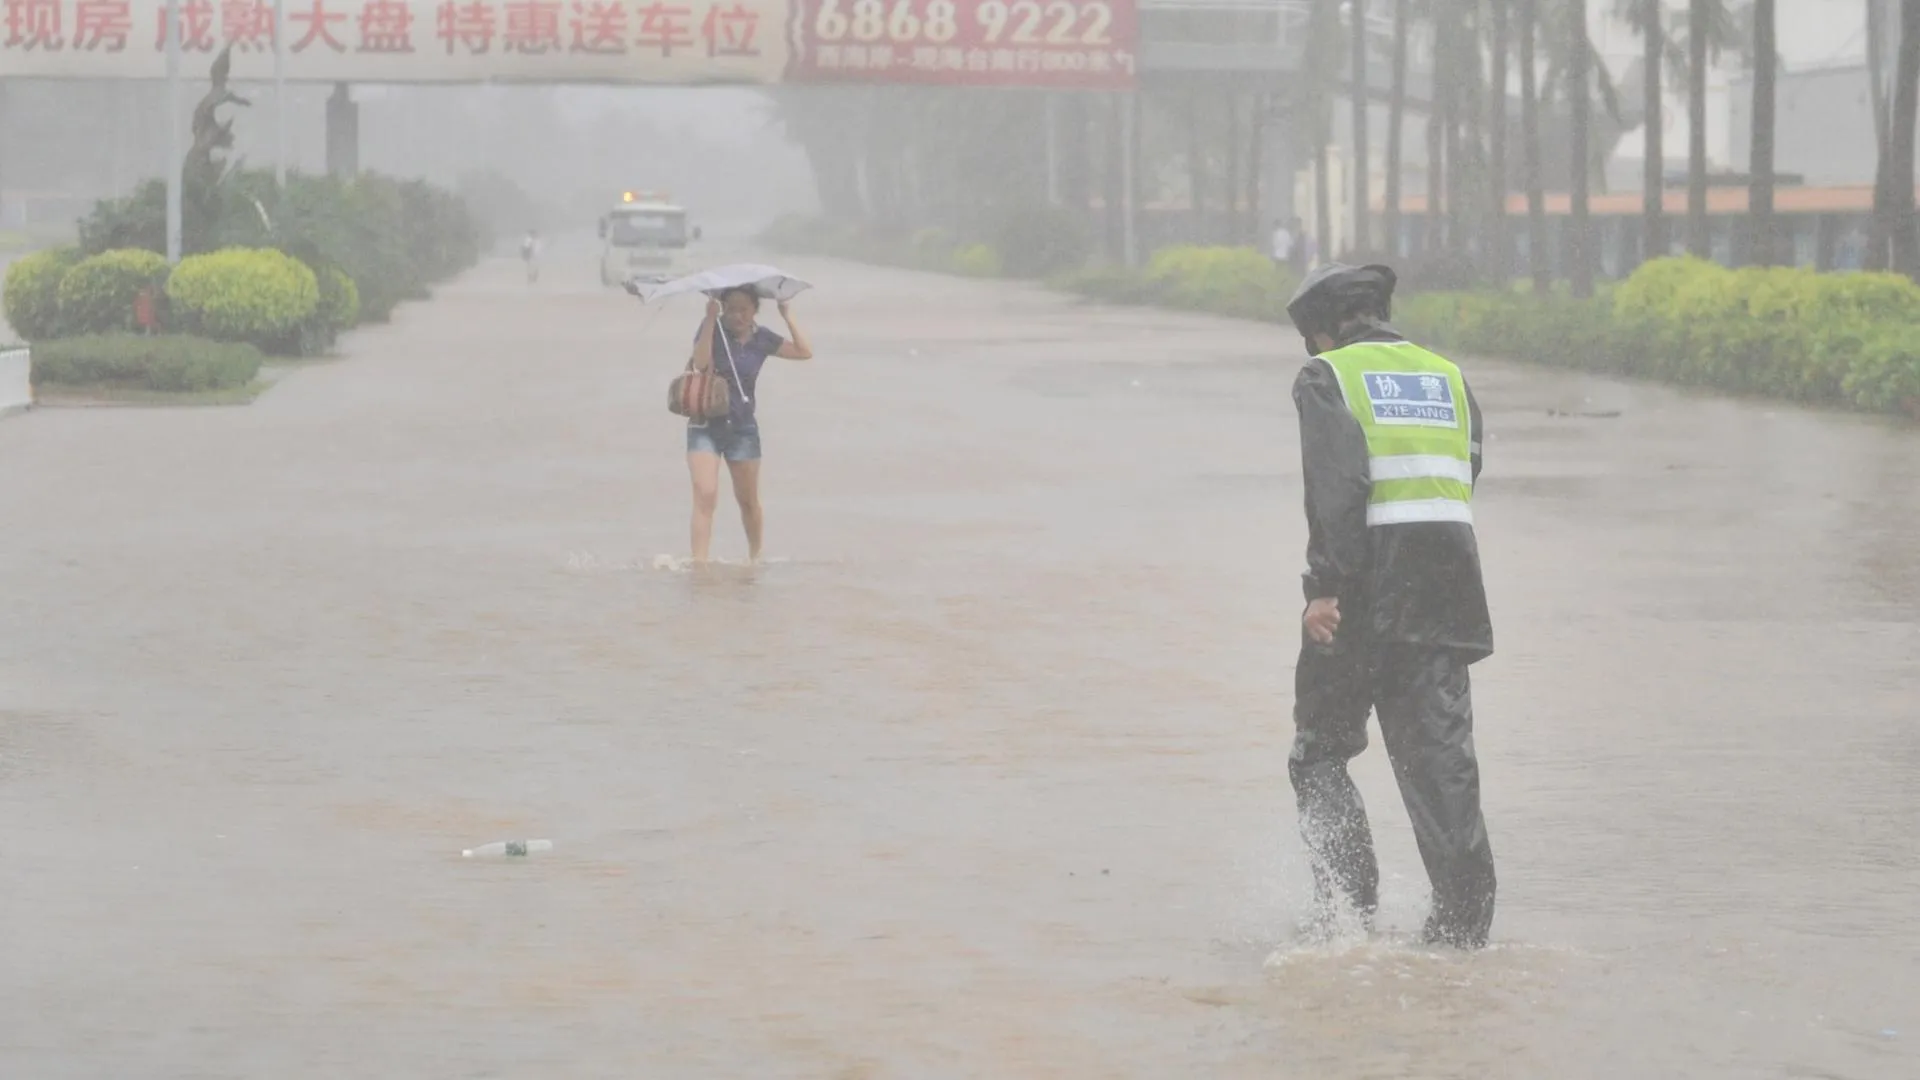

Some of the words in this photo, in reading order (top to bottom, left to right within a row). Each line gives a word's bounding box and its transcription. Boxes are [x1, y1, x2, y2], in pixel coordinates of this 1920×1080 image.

[3, 0, 132, 53] 现房
[154, 0, 417, 54] 成熟大盘
[436, 0, 761, 57] 特惠送车位
[815, 0, 957, 42] 6868
[976, 0, 1113, 45] 9222
[1375, 375, 1443, 400] 协警
[1381, 405, 1410, 417] XIE
[1414, 407, 1450, 420] JING
